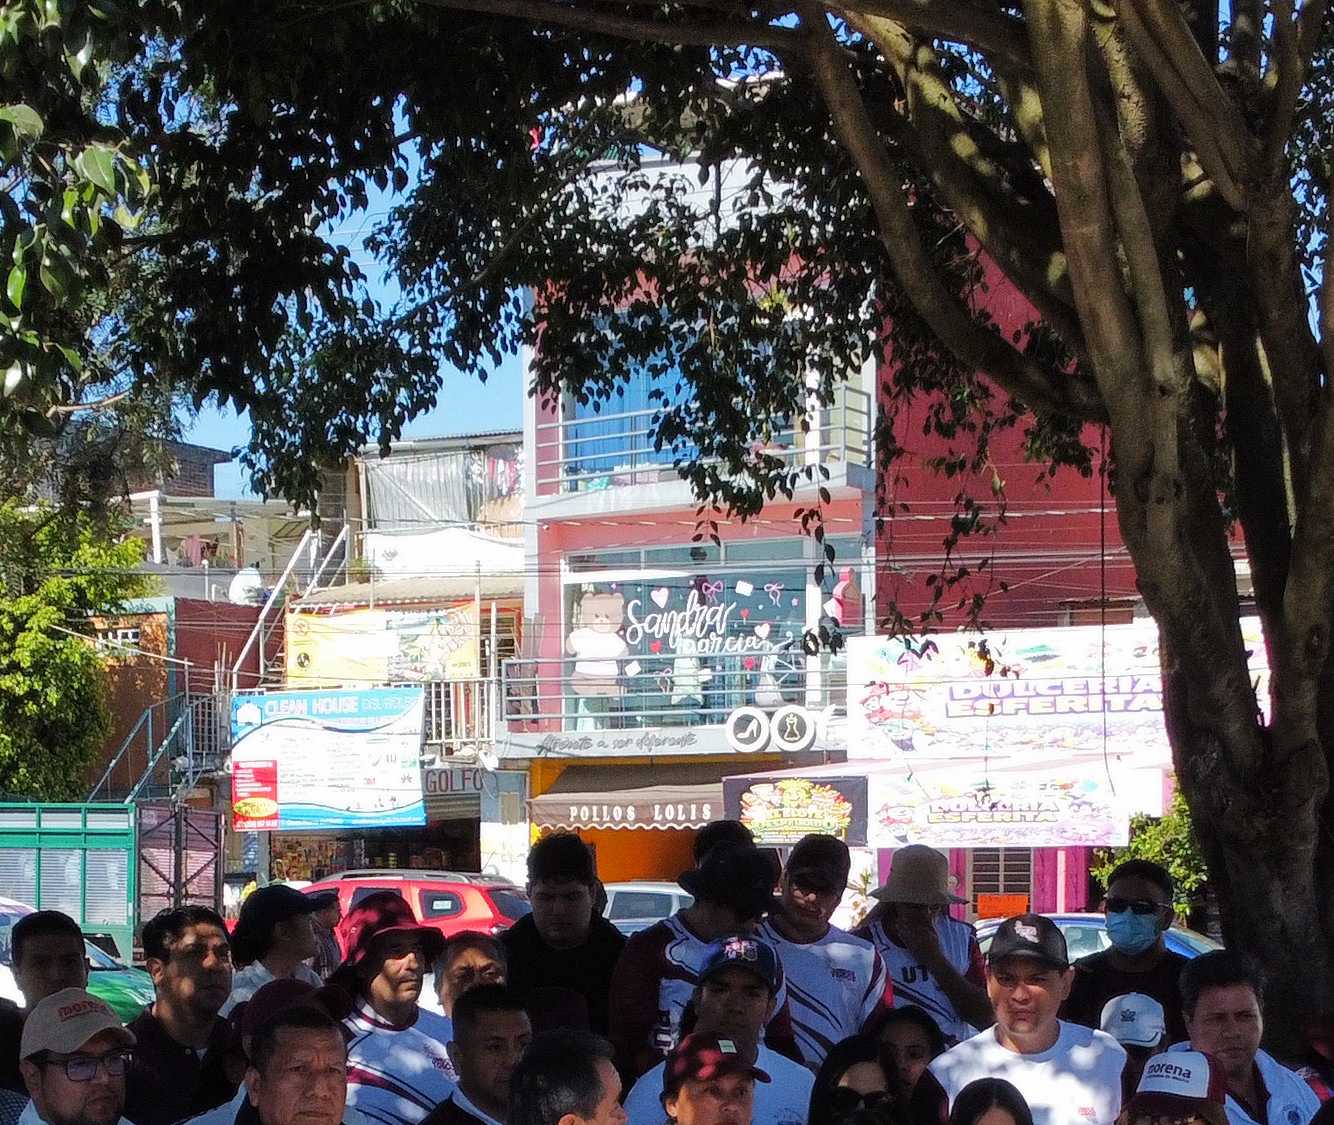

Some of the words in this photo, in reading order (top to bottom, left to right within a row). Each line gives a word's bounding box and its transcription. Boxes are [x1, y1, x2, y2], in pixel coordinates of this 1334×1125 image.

[626, 589, 737, 646] Sandra
[264, 698, 309, 717] CLEAN
[312, 695, 359, 715] HOUSE
[945, 692, 1162, 718] ESFERITA
[425, 768, 485, 793] GOLFO
[569, 805, 636, 822] POLLOS
[653, 803, 712, 821] LOLIS
[926, 811, 1059, 824] ESFERITA
[1146, 1062, 1192, 1080] morena
